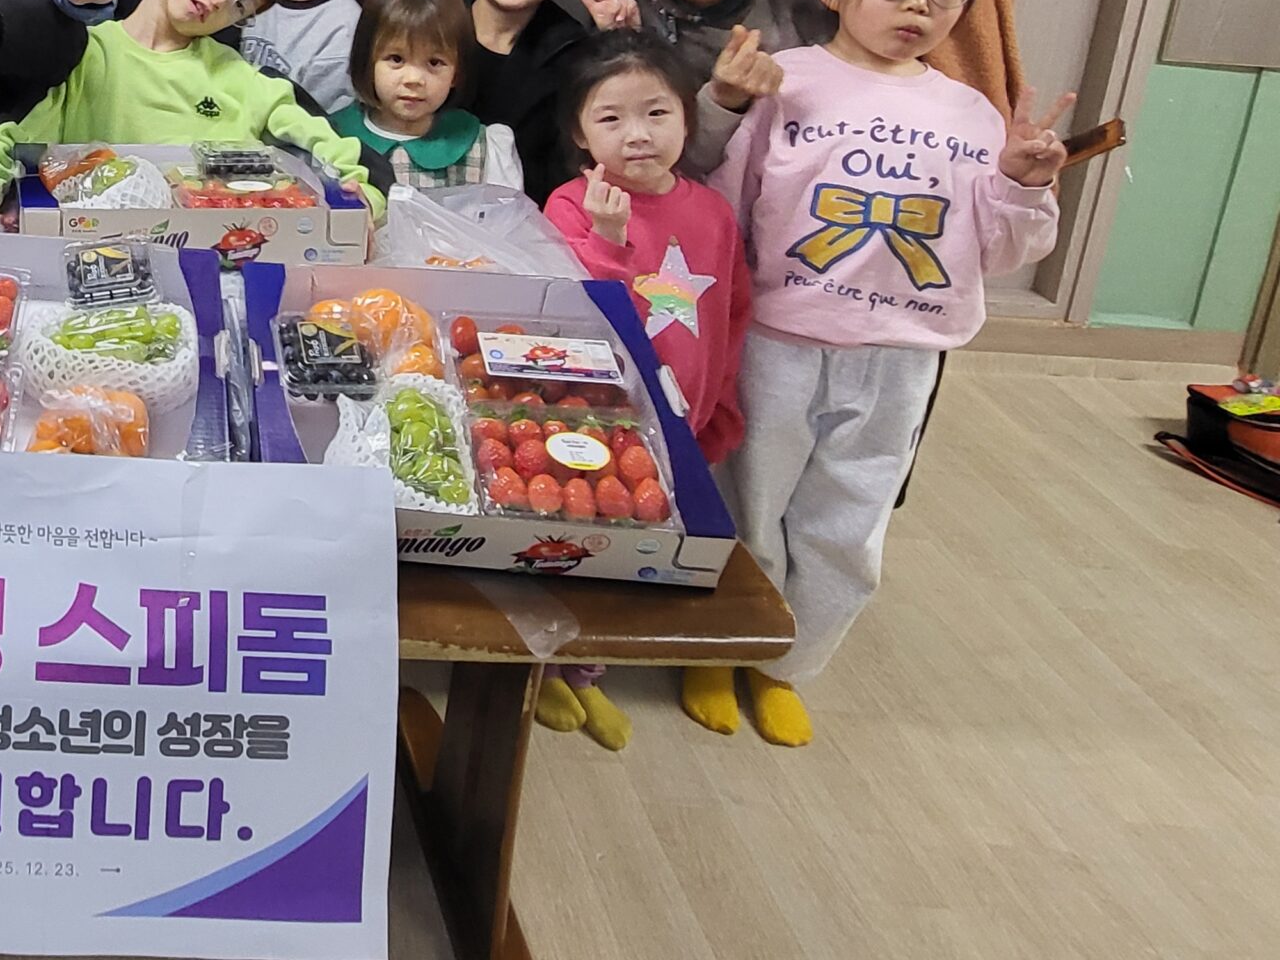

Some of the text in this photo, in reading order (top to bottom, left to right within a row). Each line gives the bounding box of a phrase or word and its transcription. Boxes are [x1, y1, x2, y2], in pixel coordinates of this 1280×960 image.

[784, 117, 989, 164] Peut-être que
[842, 149, 940, 188] Oui,
[868, 292, 898, 311] que
[905, 298, 947, 316] non.
[37, 526, 80, 547] 마음을
[398, 537, 486, 557] mango
[35, 582, 332, 696] 스피돔
[157, 712, 290, 759] 성장을
